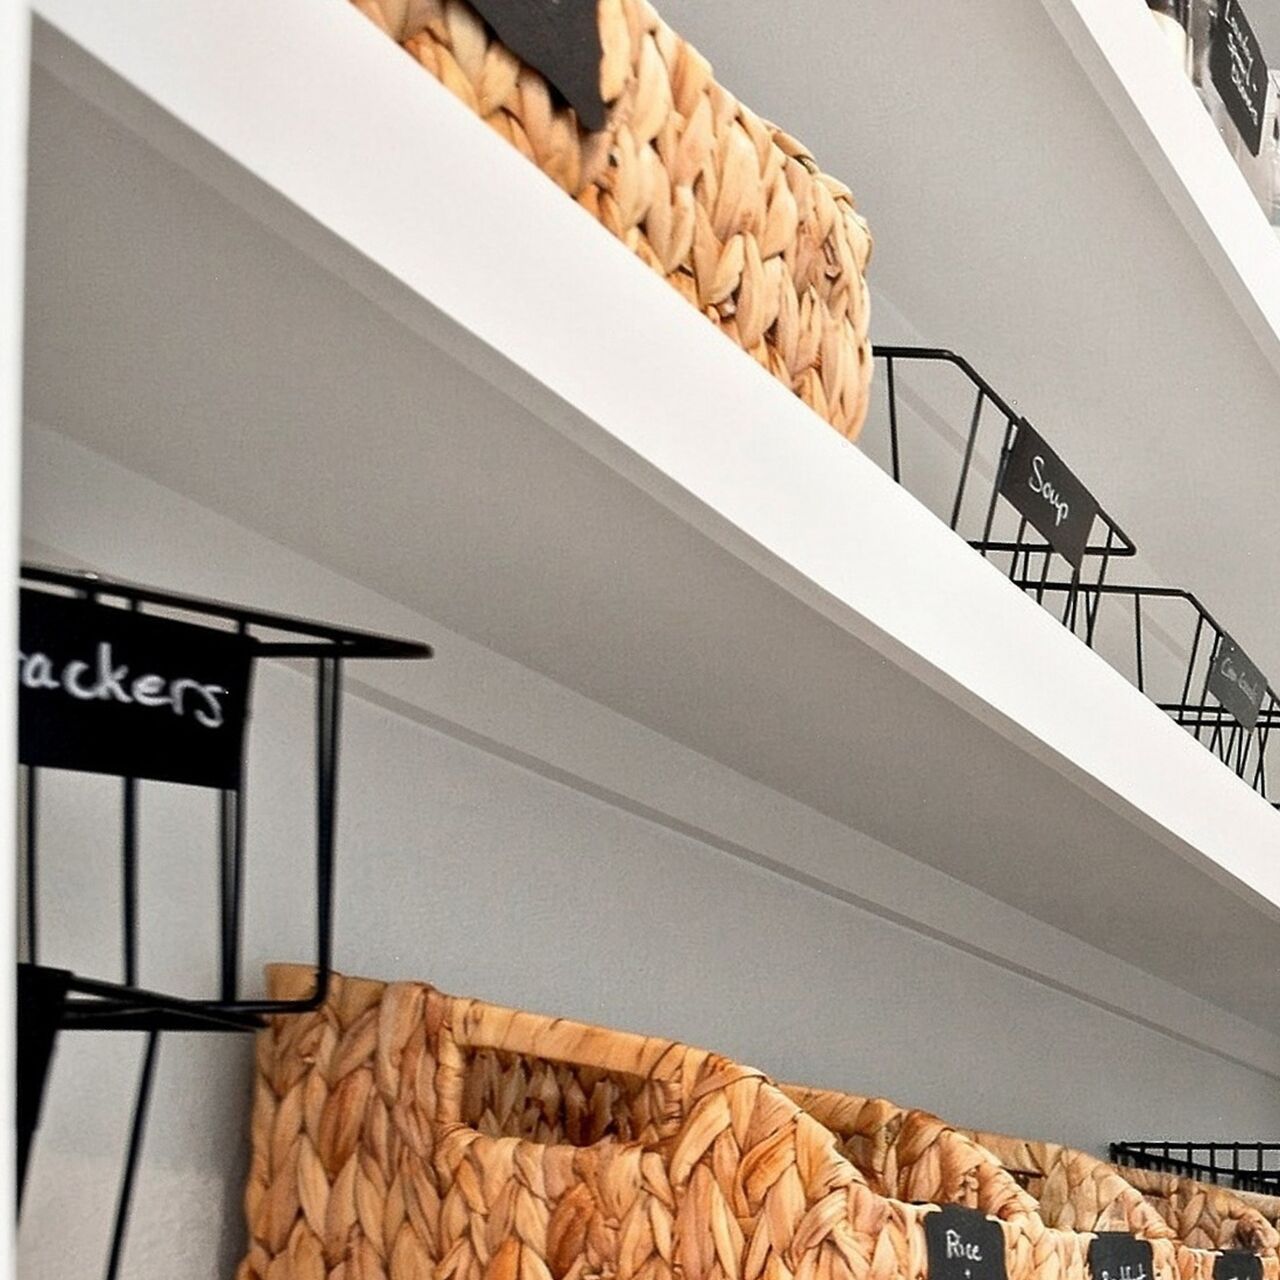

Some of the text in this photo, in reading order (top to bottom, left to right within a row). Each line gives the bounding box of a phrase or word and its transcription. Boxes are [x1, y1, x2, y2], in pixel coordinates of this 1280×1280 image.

[1028, 456, 1069, 527] Soup
[19, 641, 224, 728] ackers
[946, 1229, 983, 1260] Rice
